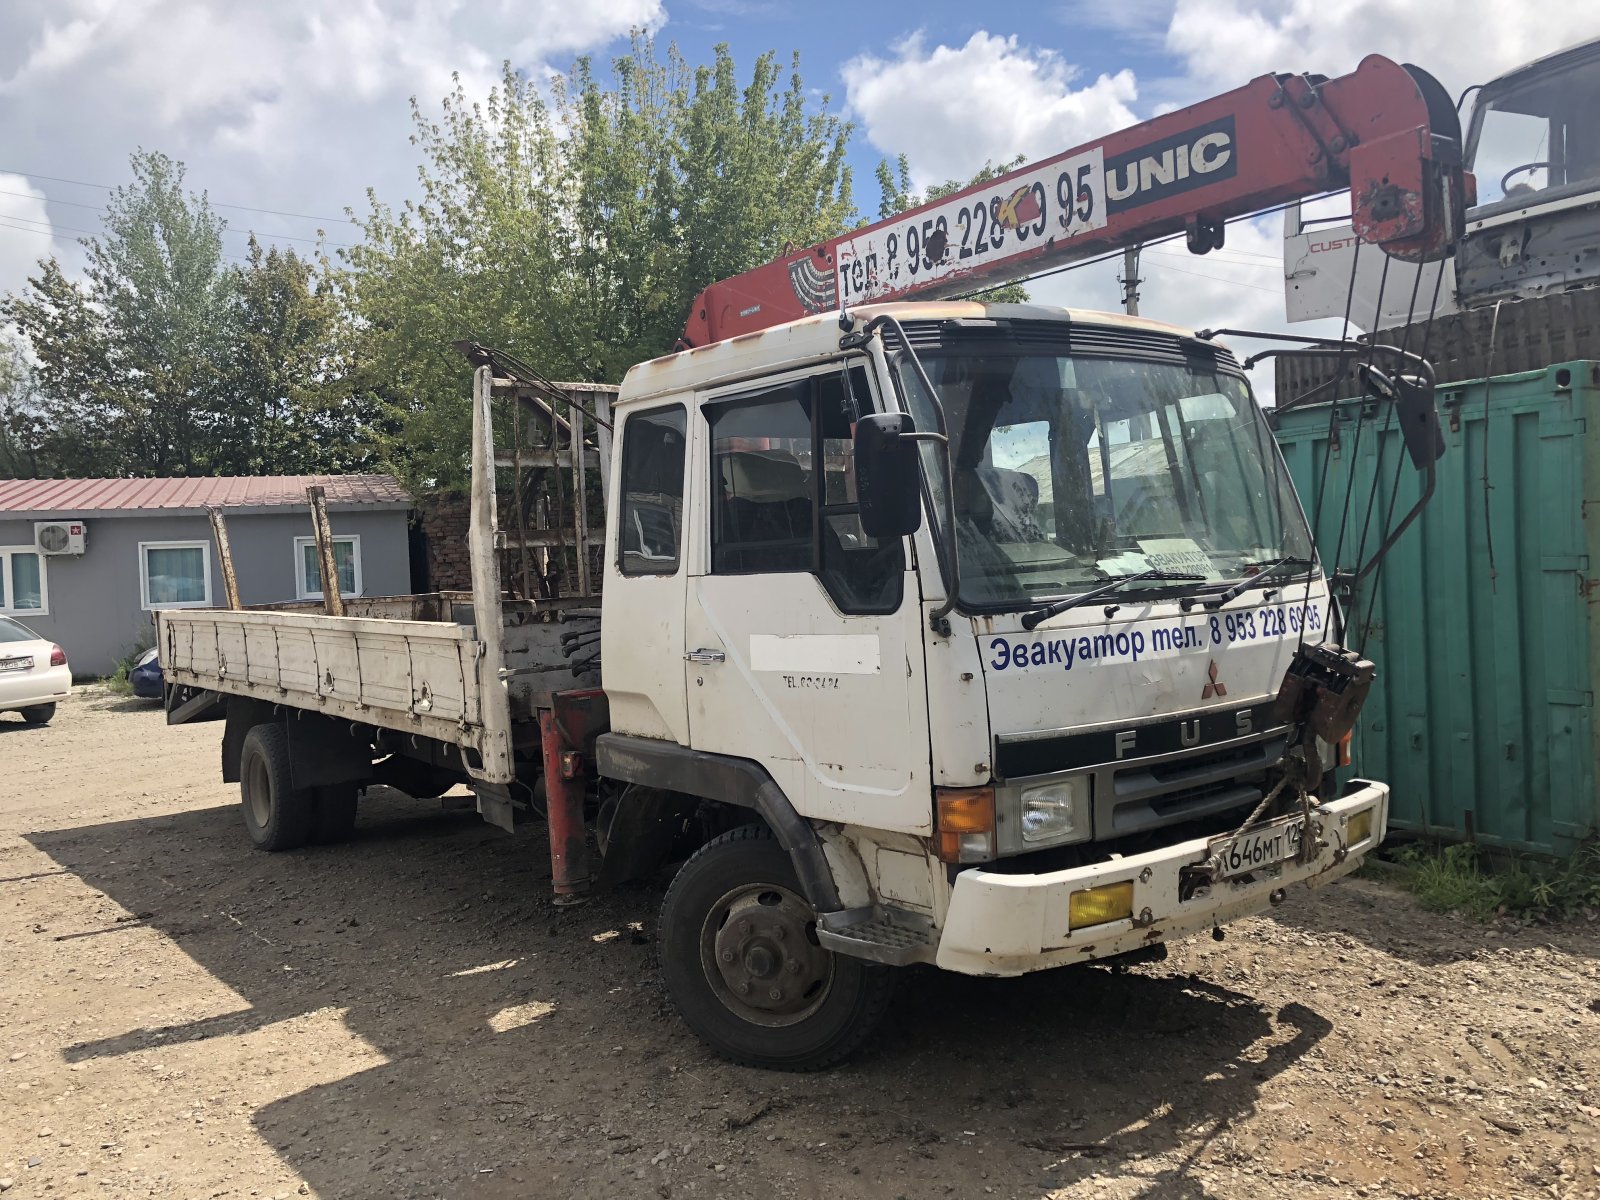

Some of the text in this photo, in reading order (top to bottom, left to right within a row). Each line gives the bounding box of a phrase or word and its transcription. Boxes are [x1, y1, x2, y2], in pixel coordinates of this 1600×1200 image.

[1106, 132, 1231, 201] UNIC
[886, 232, 900, 280] 8
[957, 195, 1005, 259] 228
[1056, 163, 1094, 229] 95
[1149, 551, 1206, 567] ЭВАКУАТОР
[990, 604, 1321, 671] Эвакуатор тел. 8 953 228 69 95
